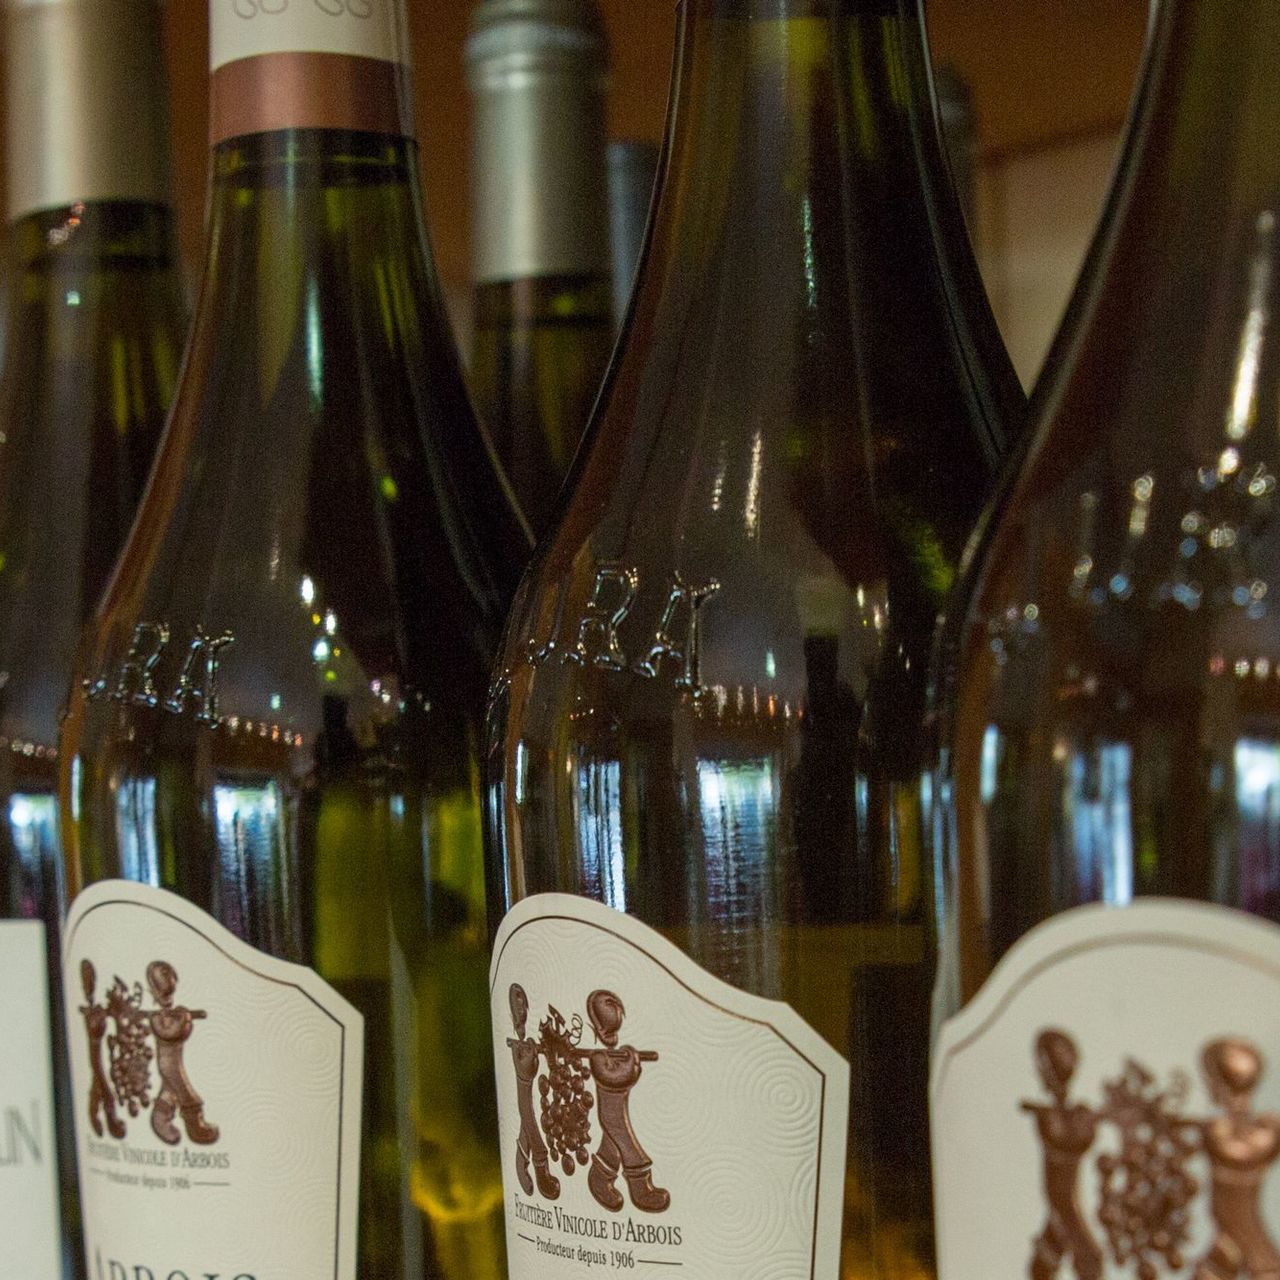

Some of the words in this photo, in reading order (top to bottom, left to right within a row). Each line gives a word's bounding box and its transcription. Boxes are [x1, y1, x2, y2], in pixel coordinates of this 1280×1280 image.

[553, 1206, 609, 1240] VINICOLE
[612, 1217, 683, 1246] D'ARBOIS
[536, 1236, 576, 1261] Producteur
[577, 1245, 608, 1267] depuis
[610, 1251, 636, 1270] 1906
